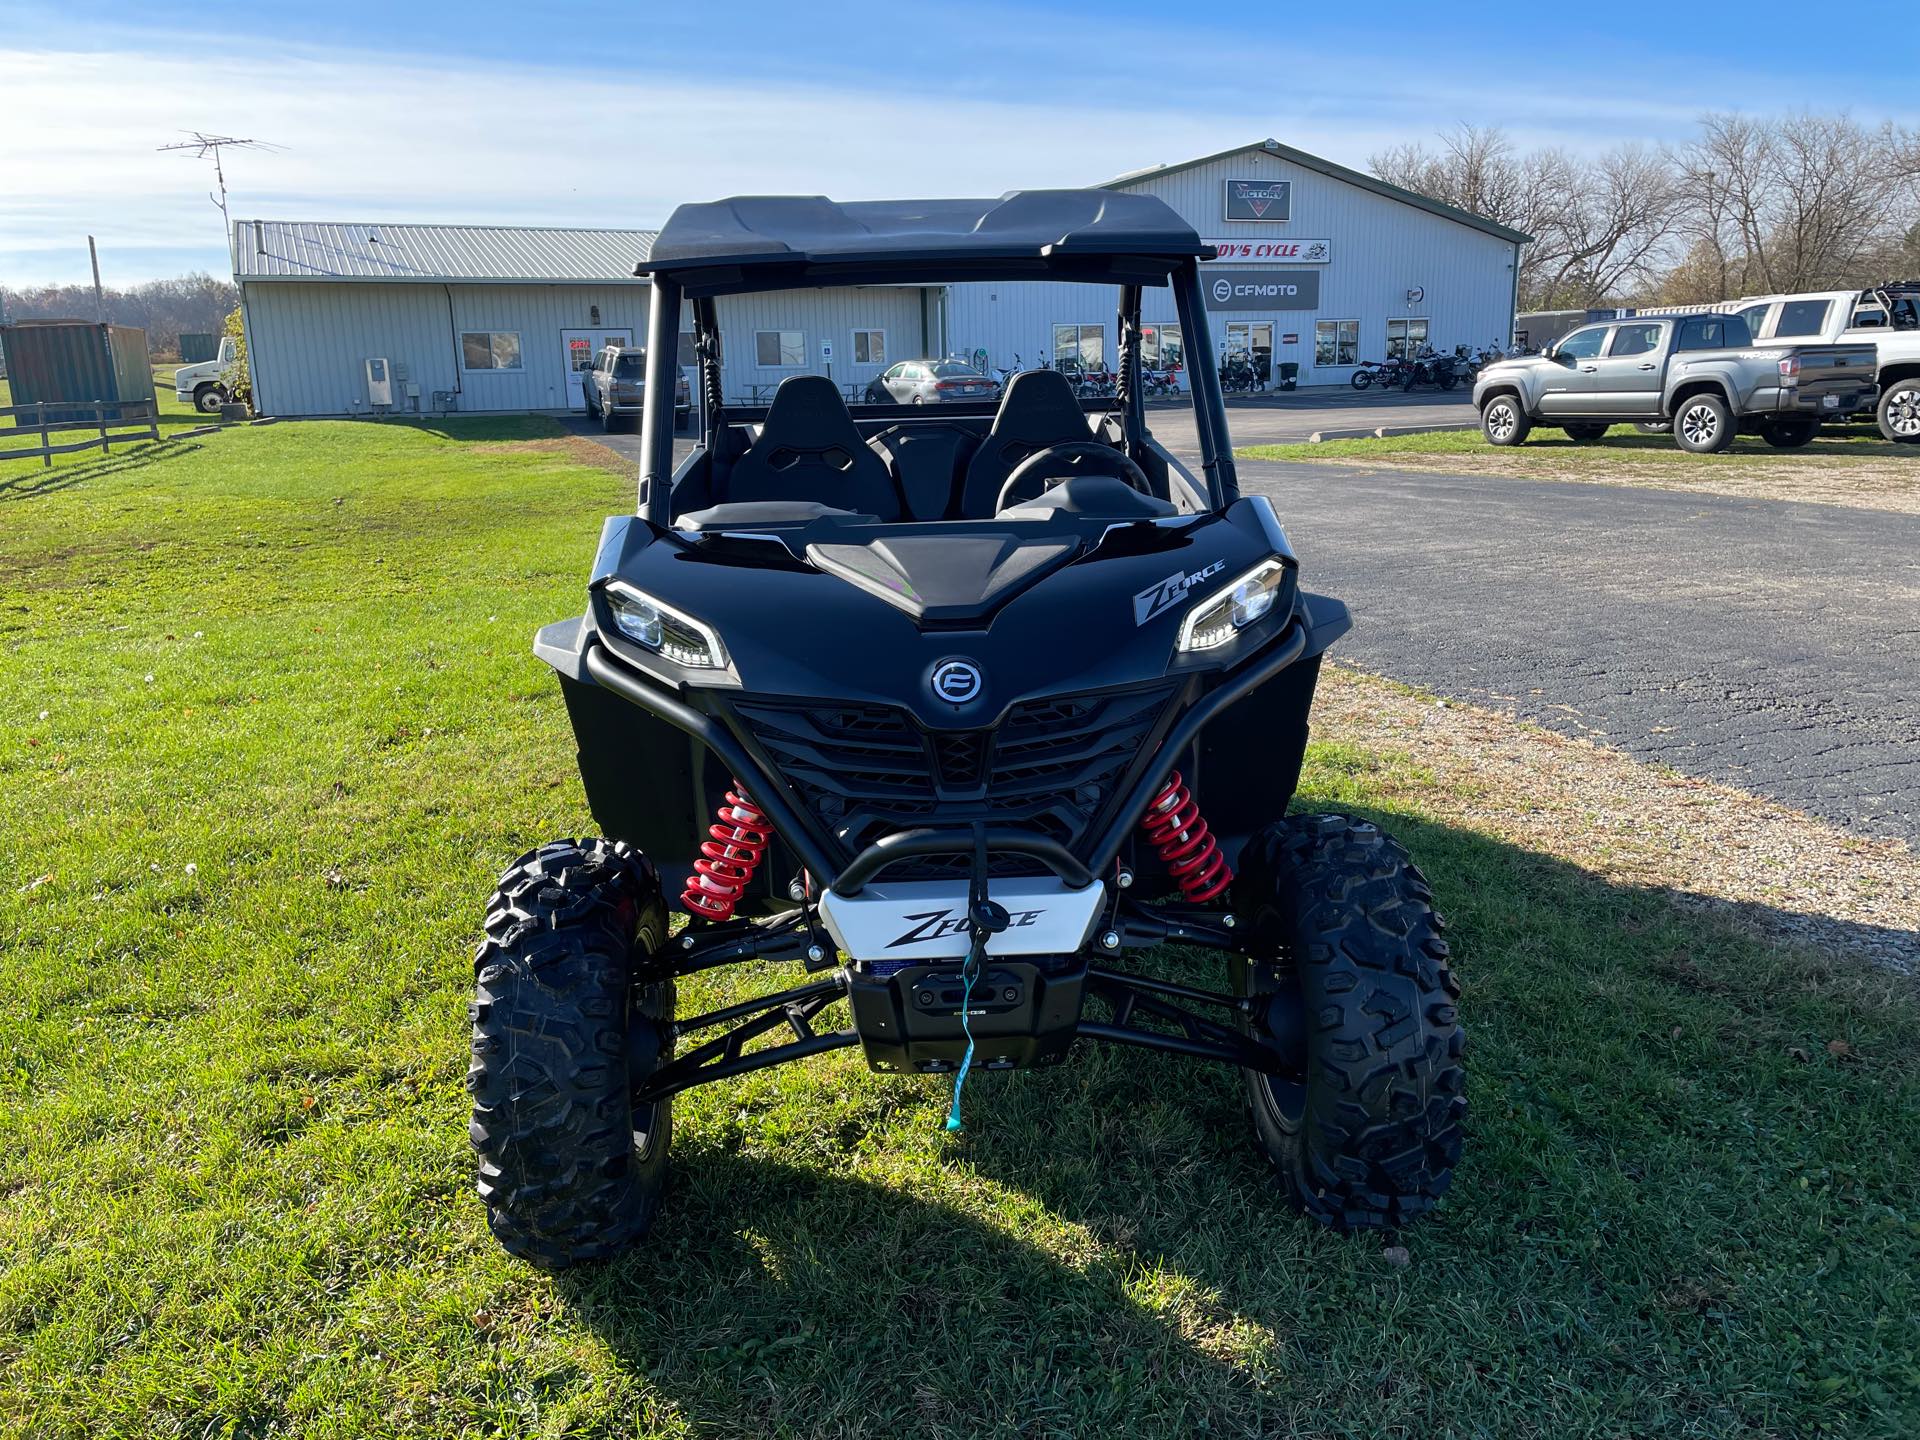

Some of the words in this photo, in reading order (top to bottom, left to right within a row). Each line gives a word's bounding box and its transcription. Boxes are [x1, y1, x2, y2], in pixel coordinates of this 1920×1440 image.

[1235, 188, 1284, 199] VICTORY
[1217, 244, 1252, 257] DY'S
[1255, 244, 1300, 257] CYCLE
[1234, 285, 1298, 296] CFMOTO
[884, 908, 1047, 949] ZFOE
